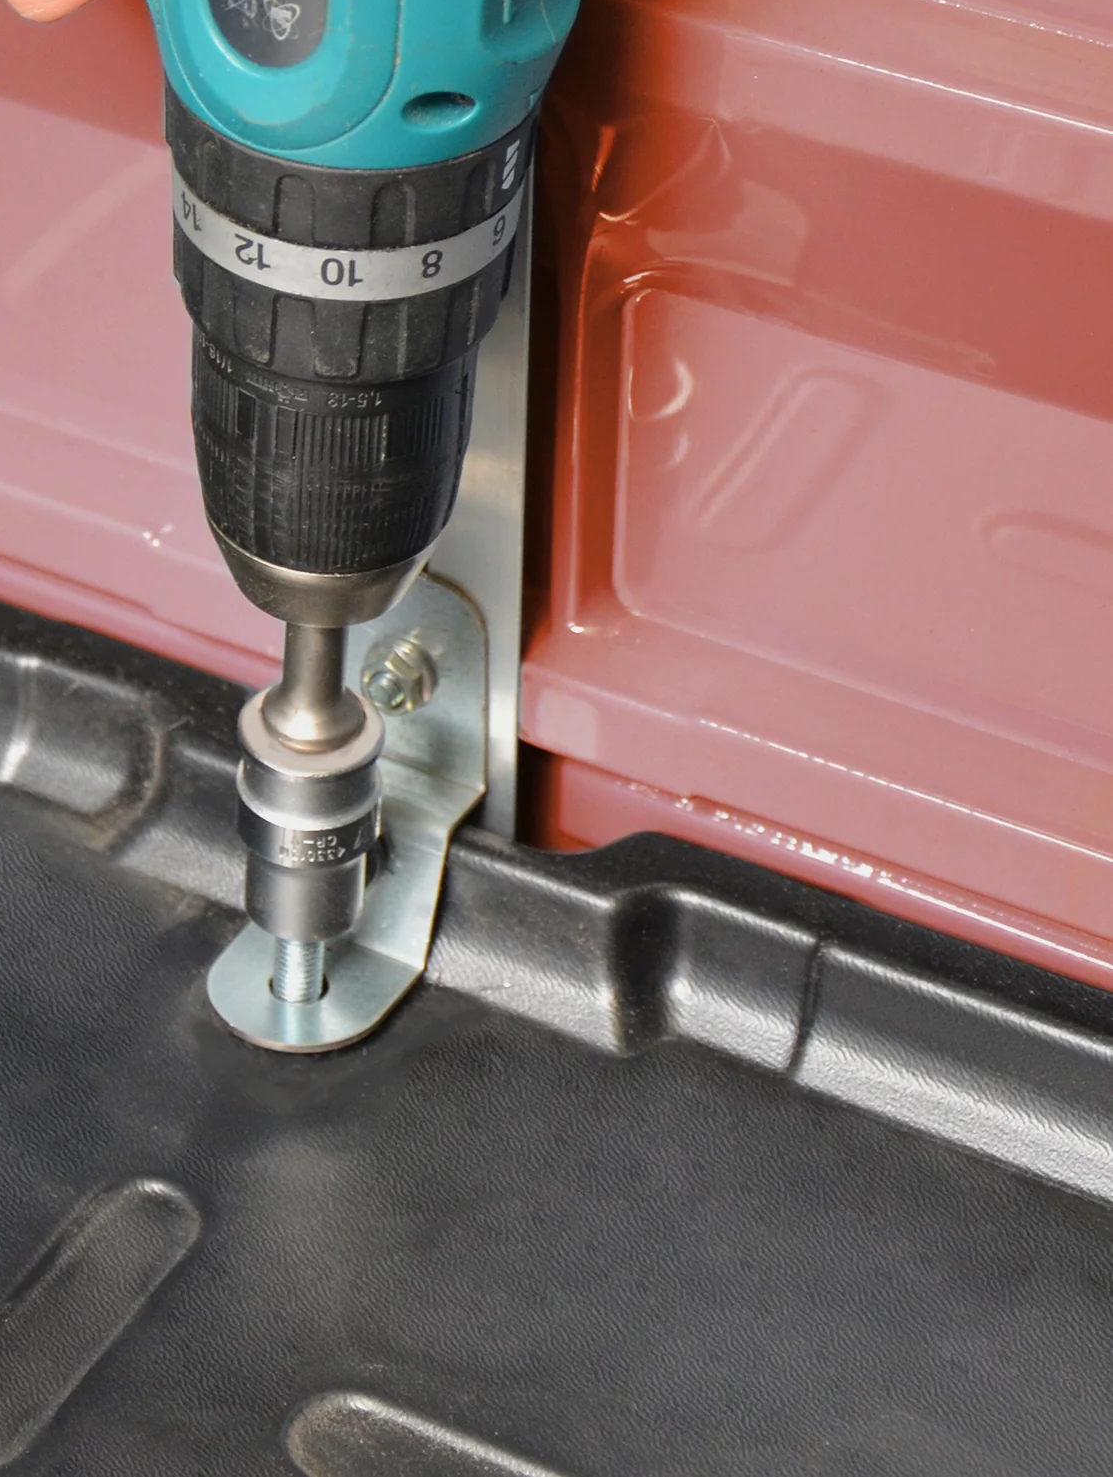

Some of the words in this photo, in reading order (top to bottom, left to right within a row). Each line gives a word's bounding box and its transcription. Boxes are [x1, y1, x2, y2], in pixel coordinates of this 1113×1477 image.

[180, 190, 202, 232] 14
[491, 214, 507, 246] 6
[235, 233, 271, 271] 12
[421, 249, 444, 279] 8
[320, 258, 363, 287] 10
